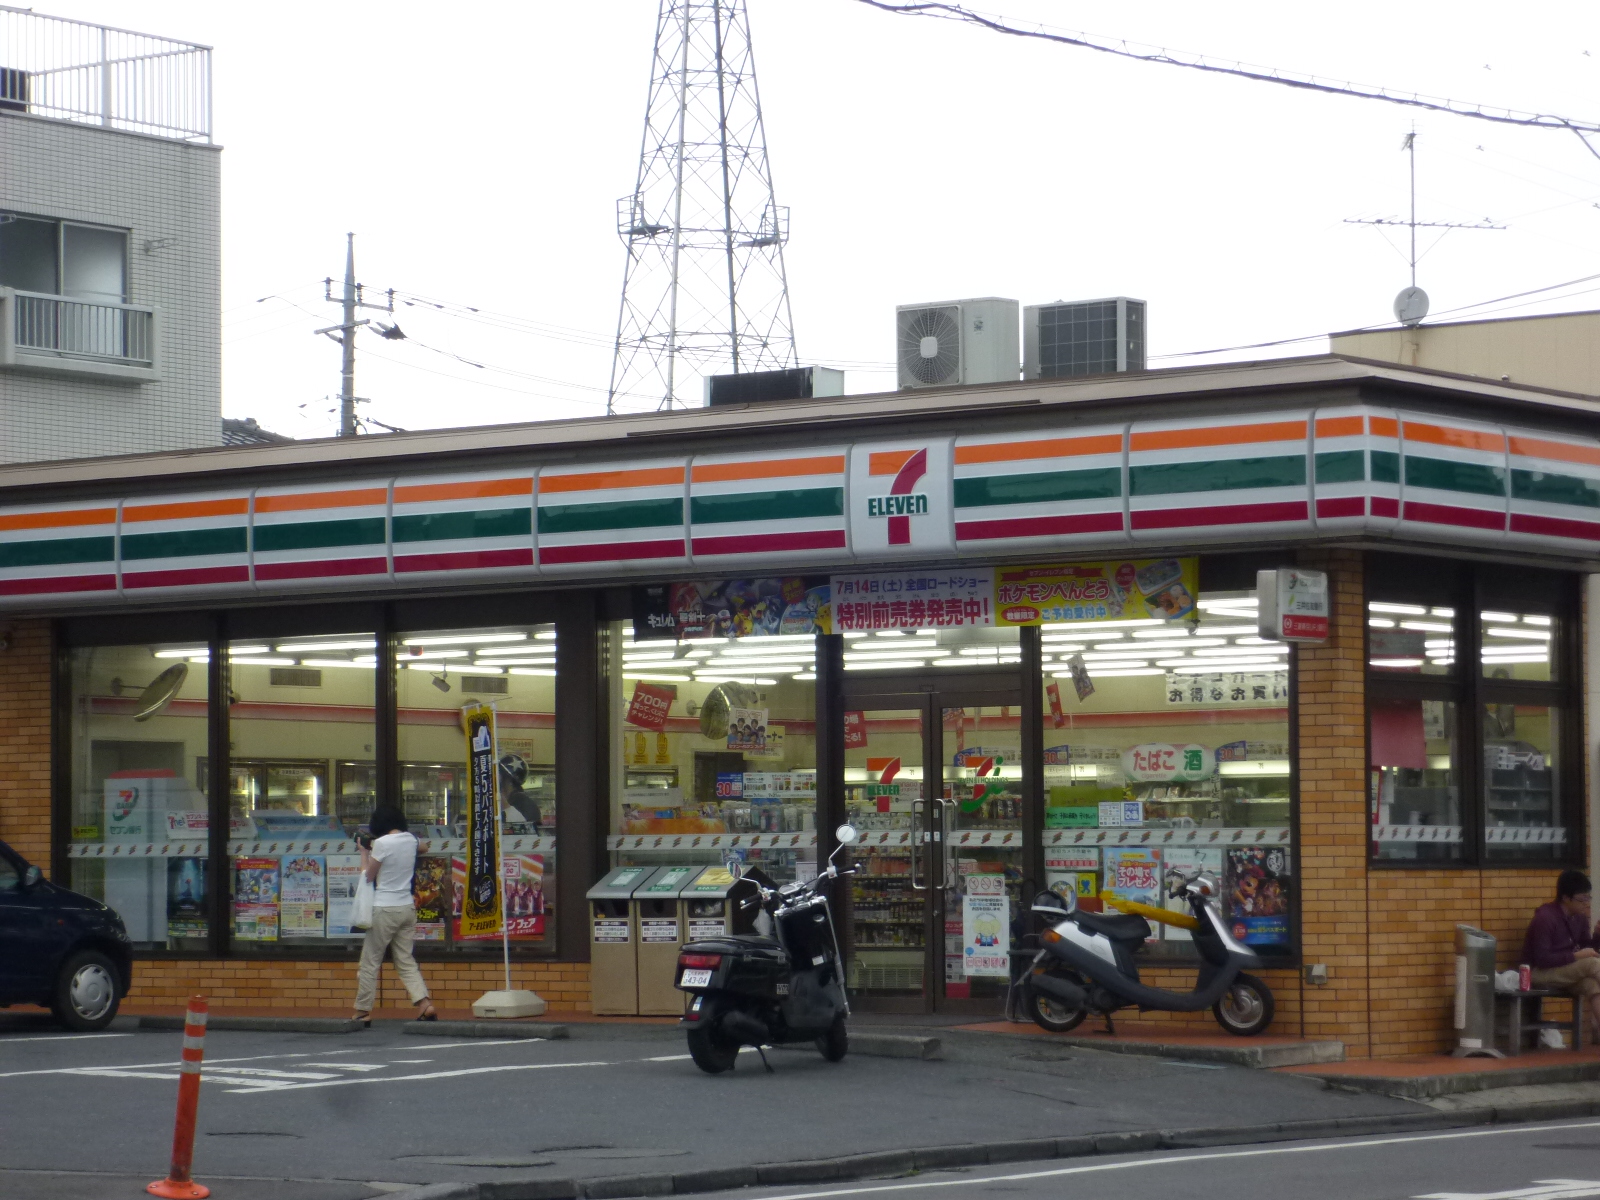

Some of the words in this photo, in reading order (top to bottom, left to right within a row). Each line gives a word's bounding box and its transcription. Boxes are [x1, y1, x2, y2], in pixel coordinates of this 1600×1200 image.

[837, 597, 990, 630] 特別前売券発売中!
[1133, 749, 1175, 771] たばこ
[1184, 749, 1202, 771] 酒
[480, 754, 489, 874] 夏5パスポート
[1118, 877, 1158, 888] プレゼント
